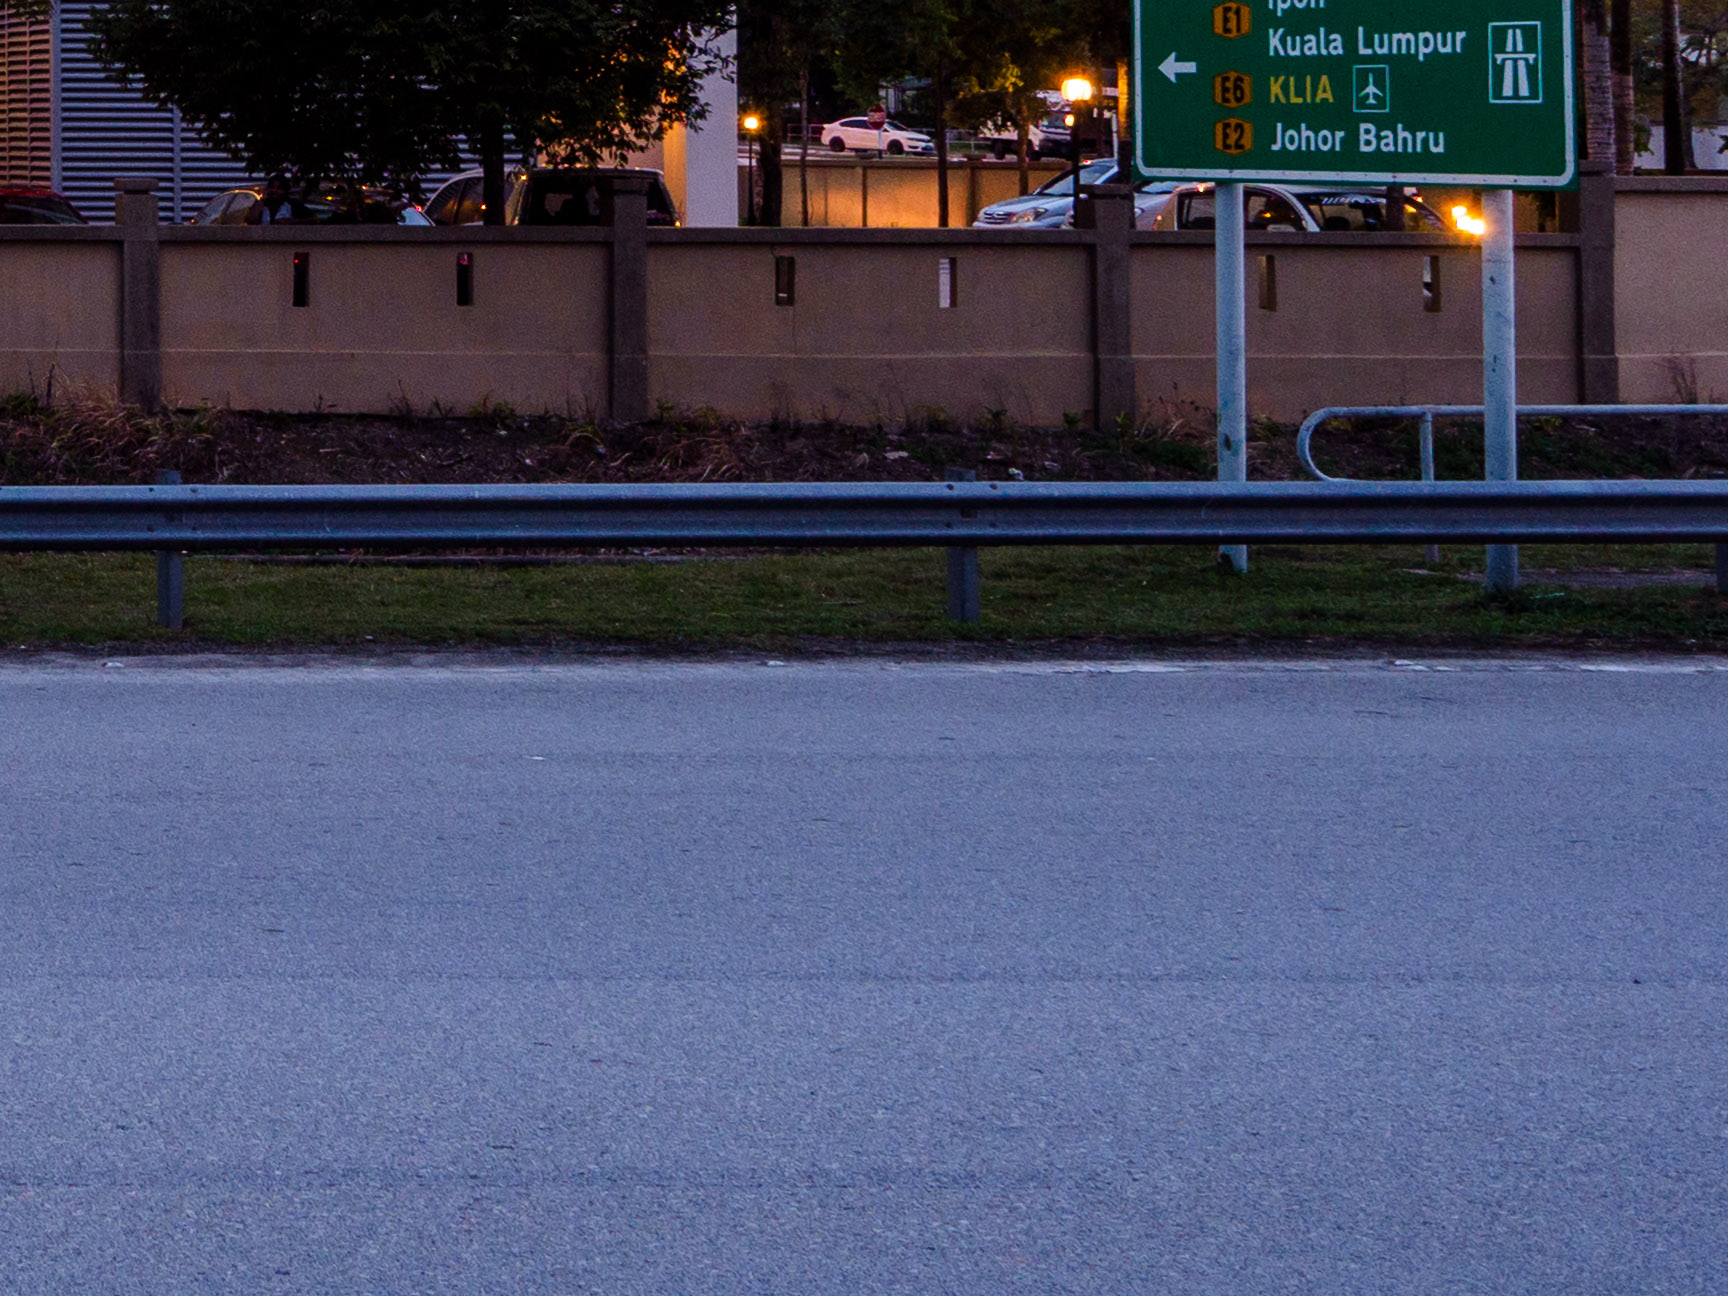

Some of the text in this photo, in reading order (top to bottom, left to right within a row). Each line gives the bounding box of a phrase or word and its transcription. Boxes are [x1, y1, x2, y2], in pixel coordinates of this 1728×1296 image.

[1221, 5, 1242, 35] E1
[1267, 25, 1467, 62] Kuala Lumpur
[1221, 74, 1335, 104] E6 KLIA
[1221, 122, 1245, 151] E2
[1270, 122, 1445, 153] Johor Bahru
